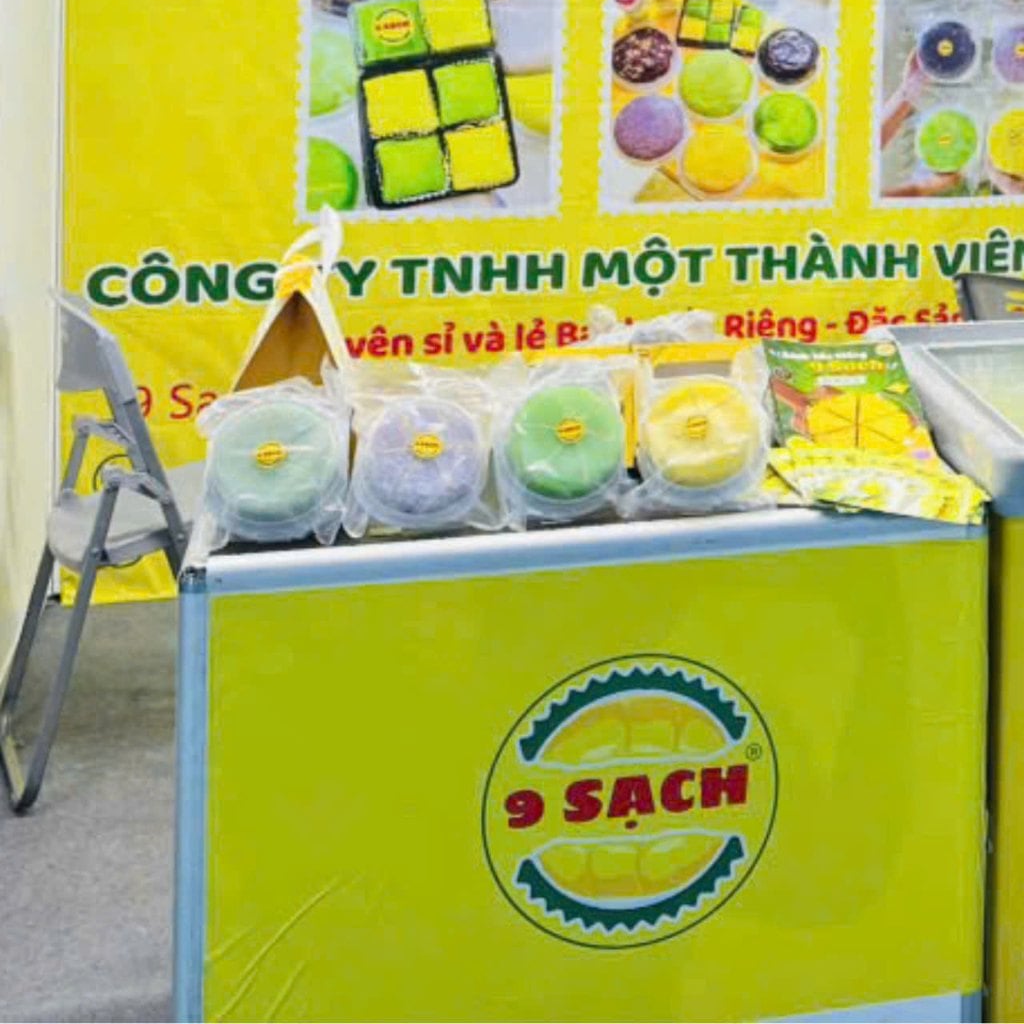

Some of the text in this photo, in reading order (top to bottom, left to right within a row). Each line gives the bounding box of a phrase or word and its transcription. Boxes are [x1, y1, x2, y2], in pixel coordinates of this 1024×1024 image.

[86, 251, 278, 307] CÔNG
[391, 251, 566, 296] TNHH
[582, 237, 712, 295] MỘT
[725, 231, 920, 282] THÀNH
[462, 320, 505, 353] và
[724, 307, 818, 344] Riêng
[503, 764, 749, 830] 9 SẠCH
